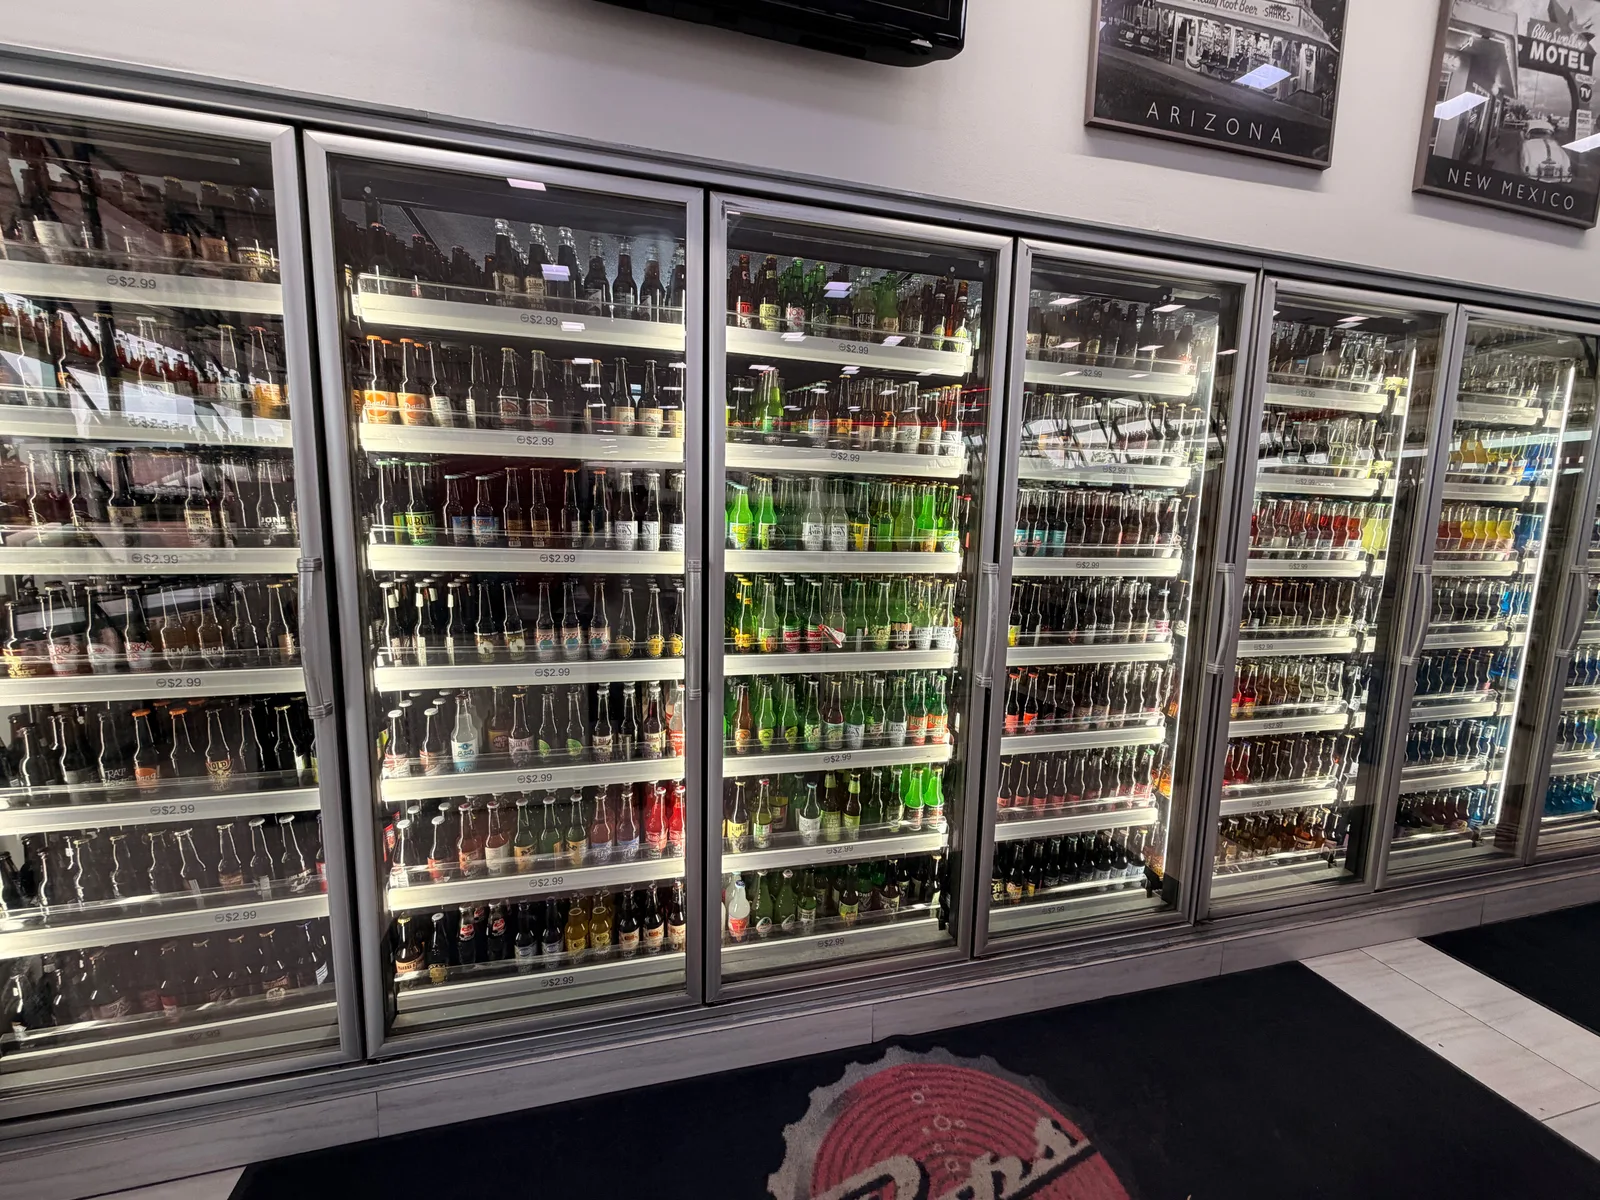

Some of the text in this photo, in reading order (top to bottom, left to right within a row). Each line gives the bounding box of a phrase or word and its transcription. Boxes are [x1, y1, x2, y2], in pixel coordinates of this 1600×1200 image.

[1218, 0, 1238, 10] Root
[1239, 1, 1258, 15] Beer
[1264, 7, 1291, 22] SHAKES
[1531, 23, 1552, 41] Blue
[1529, 41, 1590, 72] MOTEL
[1580, 87, 1591, 99] TV
[1147, 101, 1284, 146] ARIZONA
[1447, 167, 1576, 211] NEW MEXICO
[119, 277, 156, 290] $2.99
[530, 315, 558, 325] $2.99
[846, 344, 869, 354] $2.99
[1084, 369, 1102, 378] $2.99
[526, 436, 554, 446] $2.99
[838, 453, 860, 462] $2.99
[1109, 466, 1126, 474] $2.99
[144, 554, 178, 564] $2.99
[549, 554, 575, 563] $2.99
[1082, 561, 1099, 569] $2.99
[544, 668, 570, 677] $2.99
[167, 678, 202, 688] $2.99
[830, 753, 852, 763] $2.99
[526, 773, 552, 783] $2.99
[161, 805, 195, 815] $2.99
[834, 845, 853, 854] $2.99
[538, 877, 563, 887] $2.99
[225, 911, 256, 921] $2.99
[824, 938, 844, 947] $2.99
[549, 976, 574, 986] $2.99
